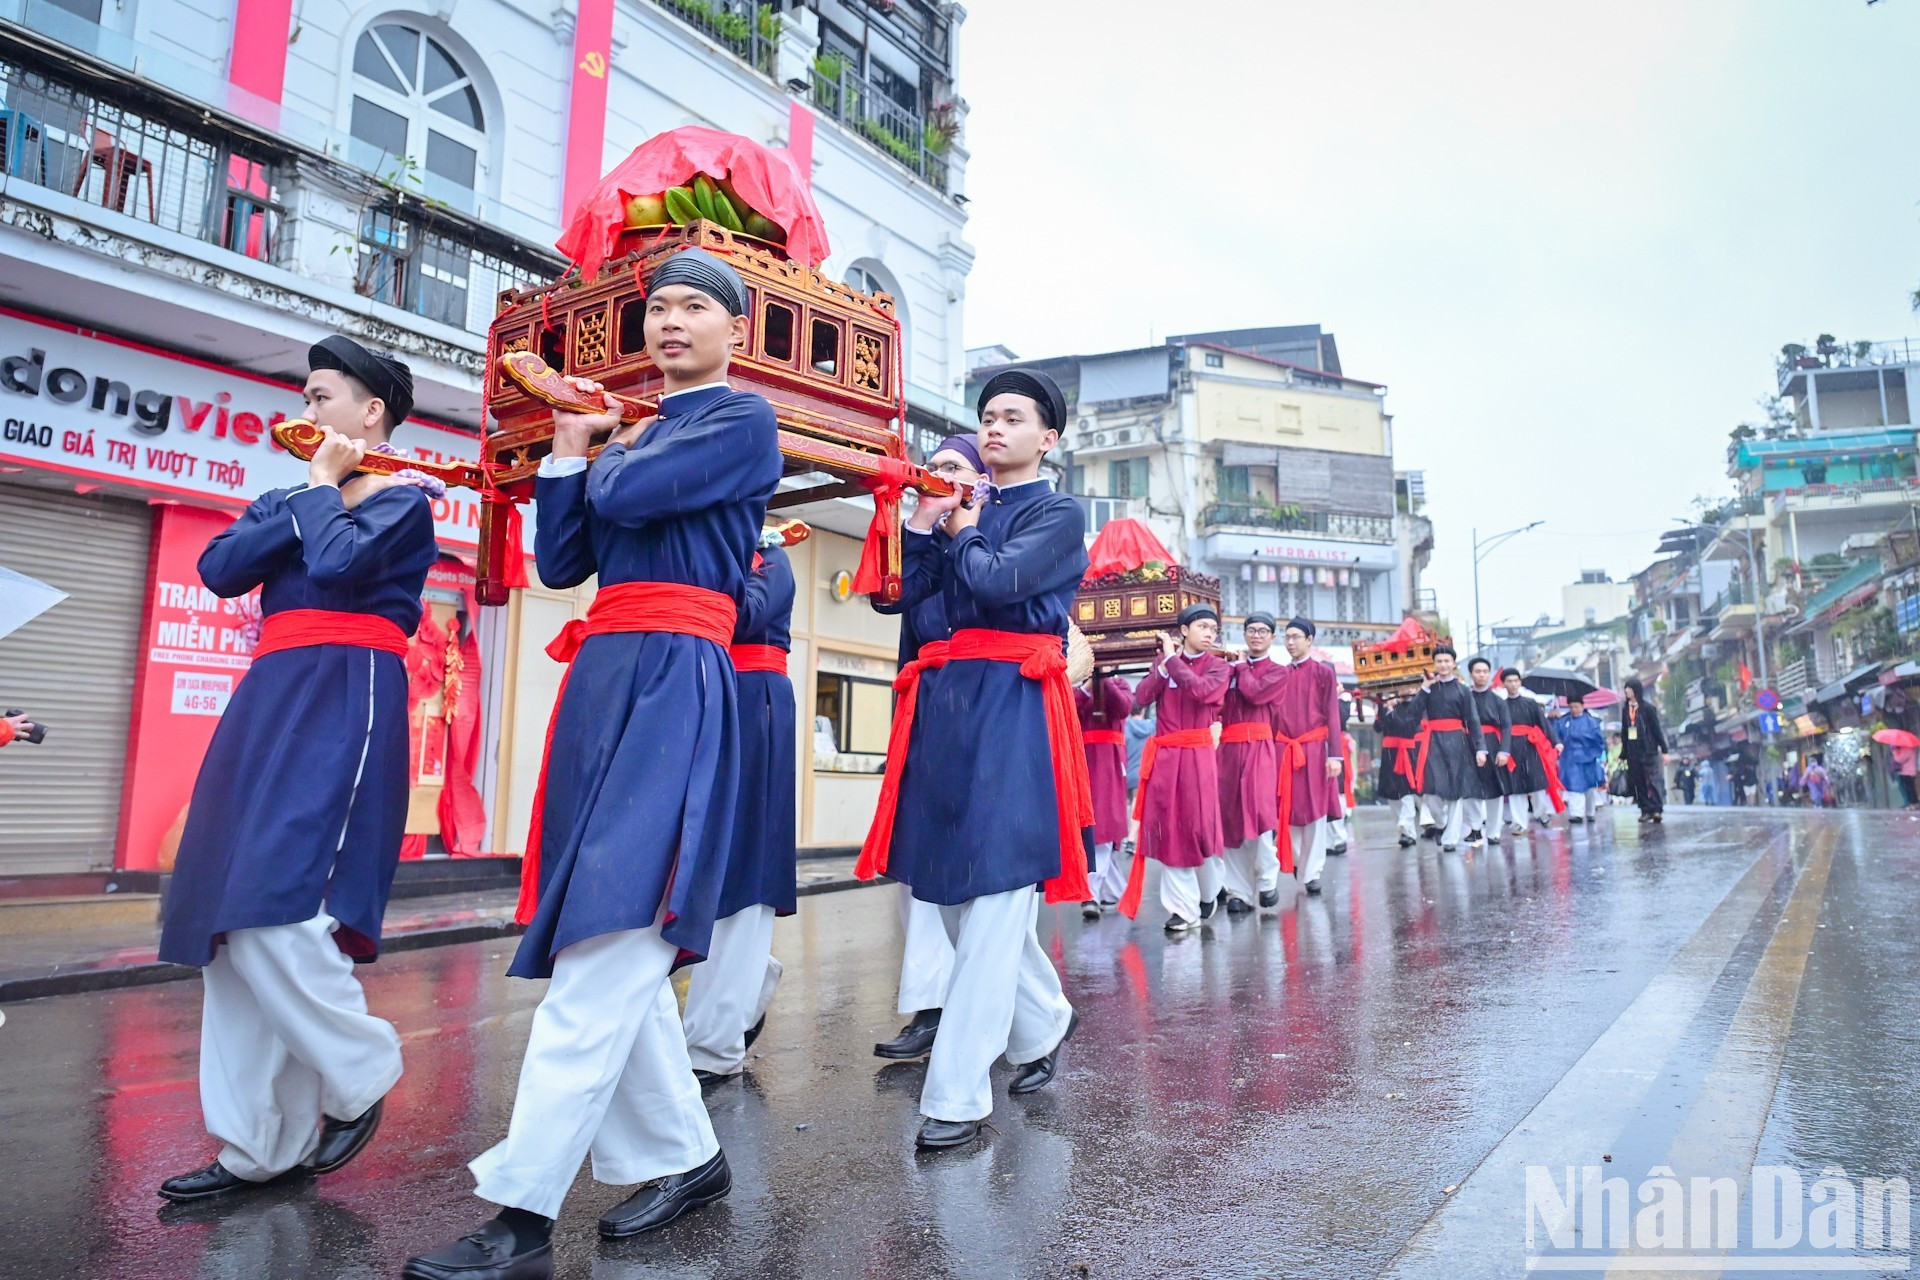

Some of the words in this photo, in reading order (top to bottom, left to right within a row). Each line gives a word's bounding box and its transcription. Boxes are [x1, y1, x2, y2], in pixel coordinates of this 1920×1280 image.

[3, 418, 53, 448] GIAO
[62, 428, 96, 458] GIÁ
[107, 439, 137, 471] TRỊ
[146, 447, 198, 478] VƯỢT
[207, 460, 246, 489] TRỘI
[1265, 546, 1348, 561] HERBALIST
[158, 582, 219, 615] TRẠM
[157, 615, 216, 651] MIỄN
[219, 627, 249, 655] PH
[153, 652, 170, 660] FREE
[171, 653, 194, 662] PHONE
[196, 655, 229, 665] CHARGING
[230, 658, 252, 667] STATIO
[184, 695, 217, 711] 4G-5G
